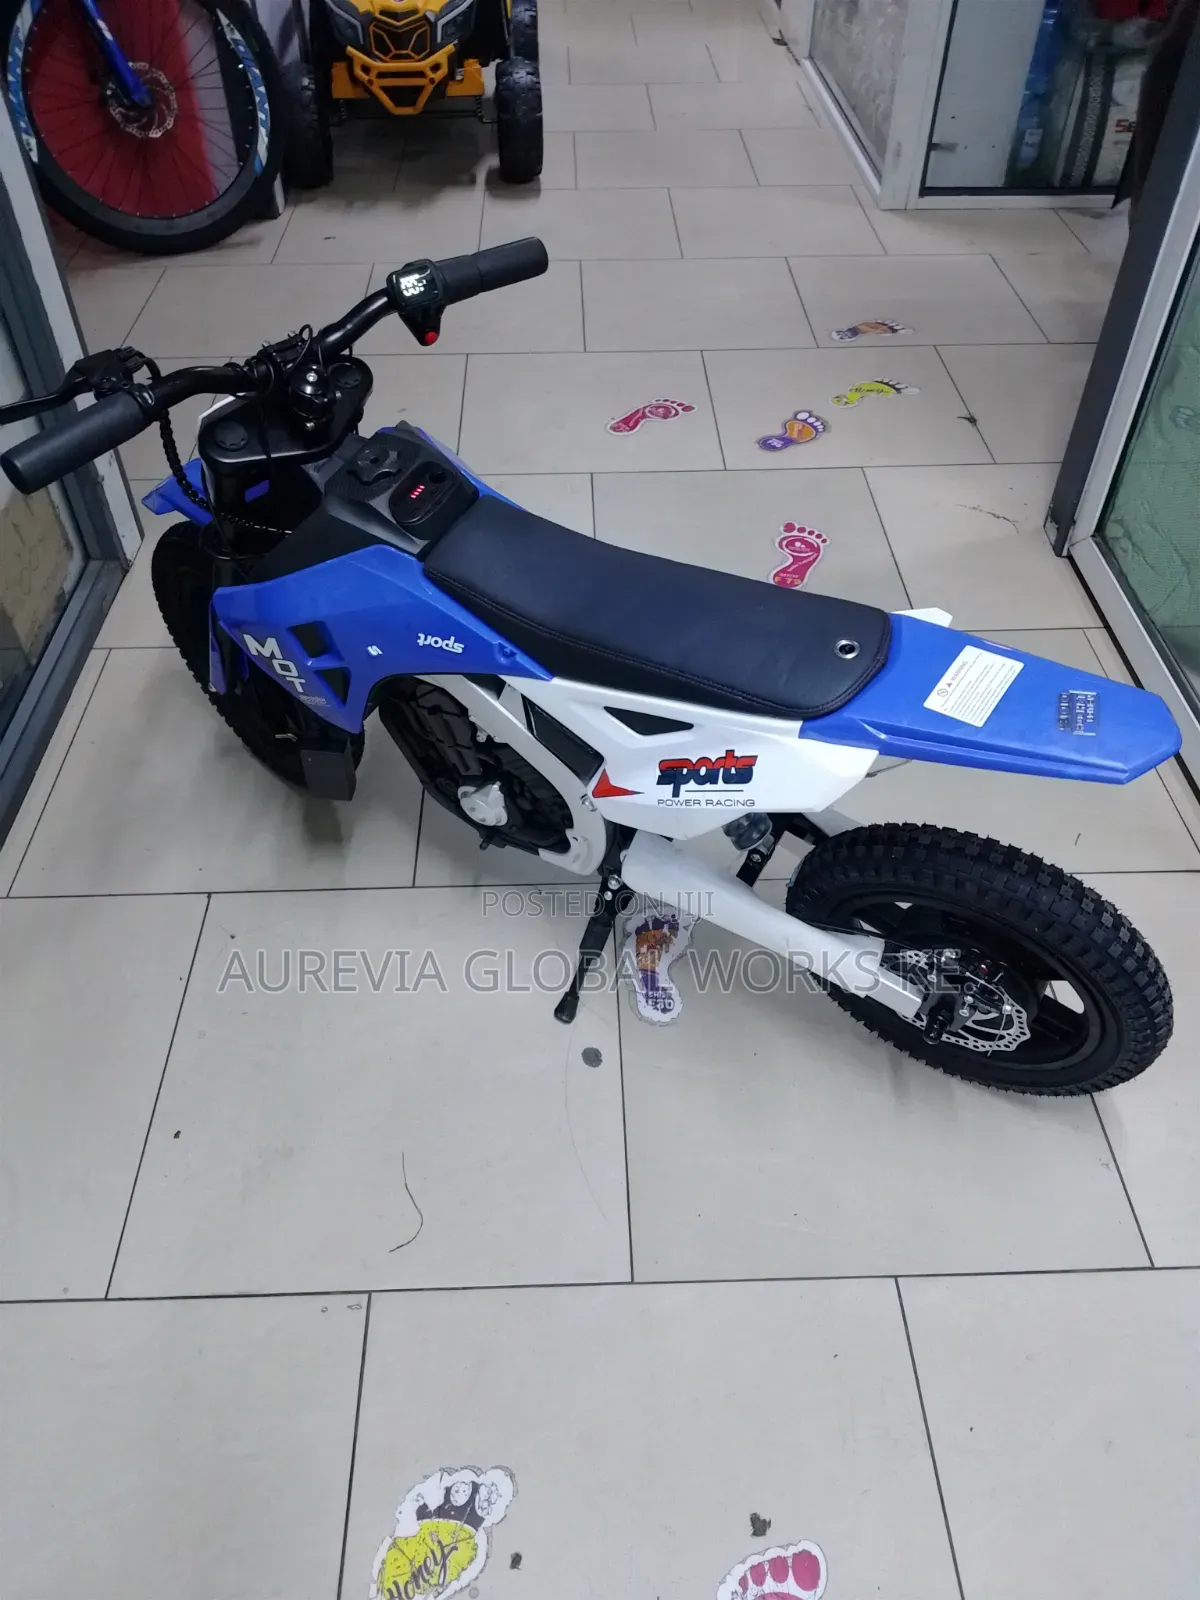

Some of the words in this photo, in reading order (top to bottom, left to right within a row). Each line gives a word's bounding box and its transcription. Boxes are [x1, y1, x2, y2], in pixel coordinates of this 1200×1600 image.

[242, 633, 306, 693] MOT
[416, 632, 465, 654] sport
[656, 749, 758, 798] sports
[657, 798, 701, 807] POWER
[705, 798, 755, 807] RACING
[386, 1539, 459, 1600] Honey
